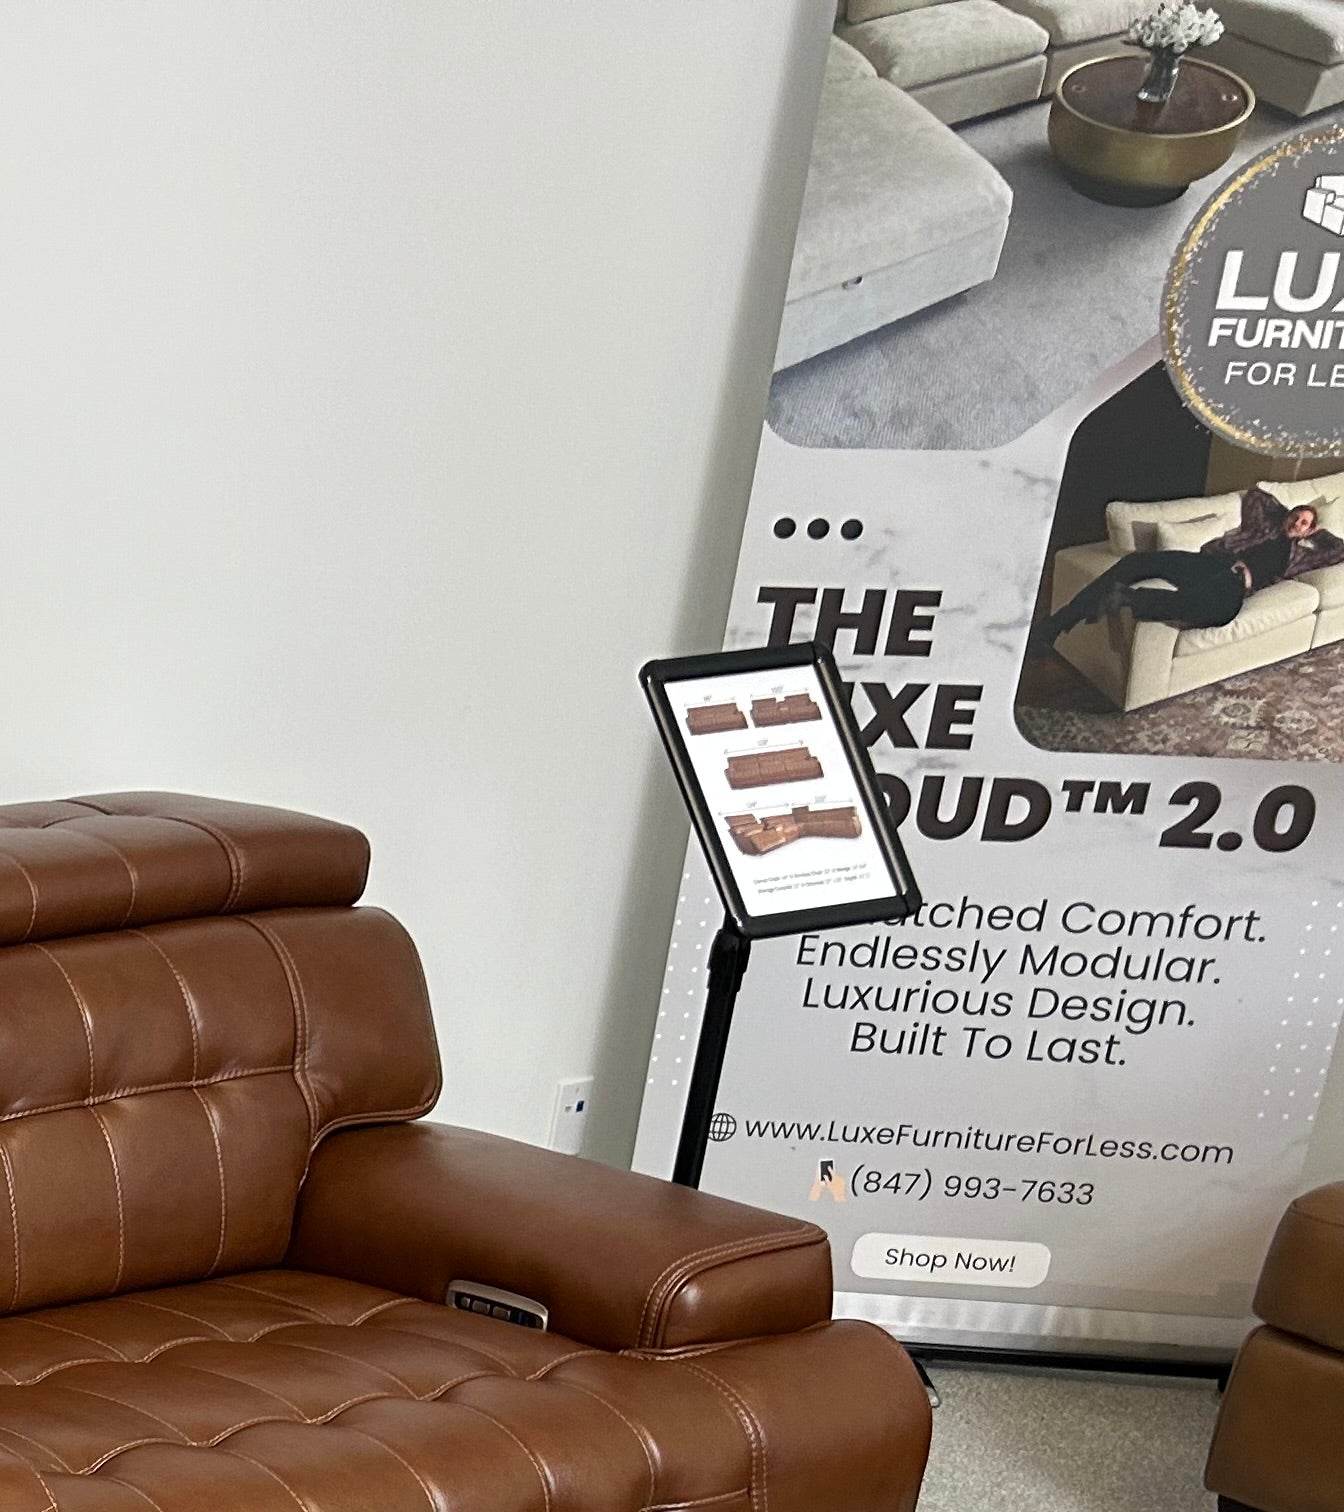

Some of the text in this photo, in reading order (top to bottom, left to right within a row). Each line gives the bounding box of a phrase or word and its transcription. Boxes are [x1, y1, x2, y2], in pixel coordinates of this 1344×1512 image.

[1216, 250, 1344, 313] LU
[1224, 361, 1297, 386] FOR
[757, 586, 943, 657] THE
[842, 681, 984, 750] XE
[1159, 780, 1317, 853] 2.0
[883, 896, 1266, 943] tched Comfort.
[796, 933, 1222, 984] Endlessly Modular.
[802, 976, 1196, 1035] Luxurious Design.
[850, 1021, 1127, 1066] Built To Last.
[745, 1117, 1235, 1165] www.LuxeFurnitureForLess.com
[849, 1163, 1095, 1205] (847) 993-7633
[885, 1246, 1016, 1273] Shop Now!
